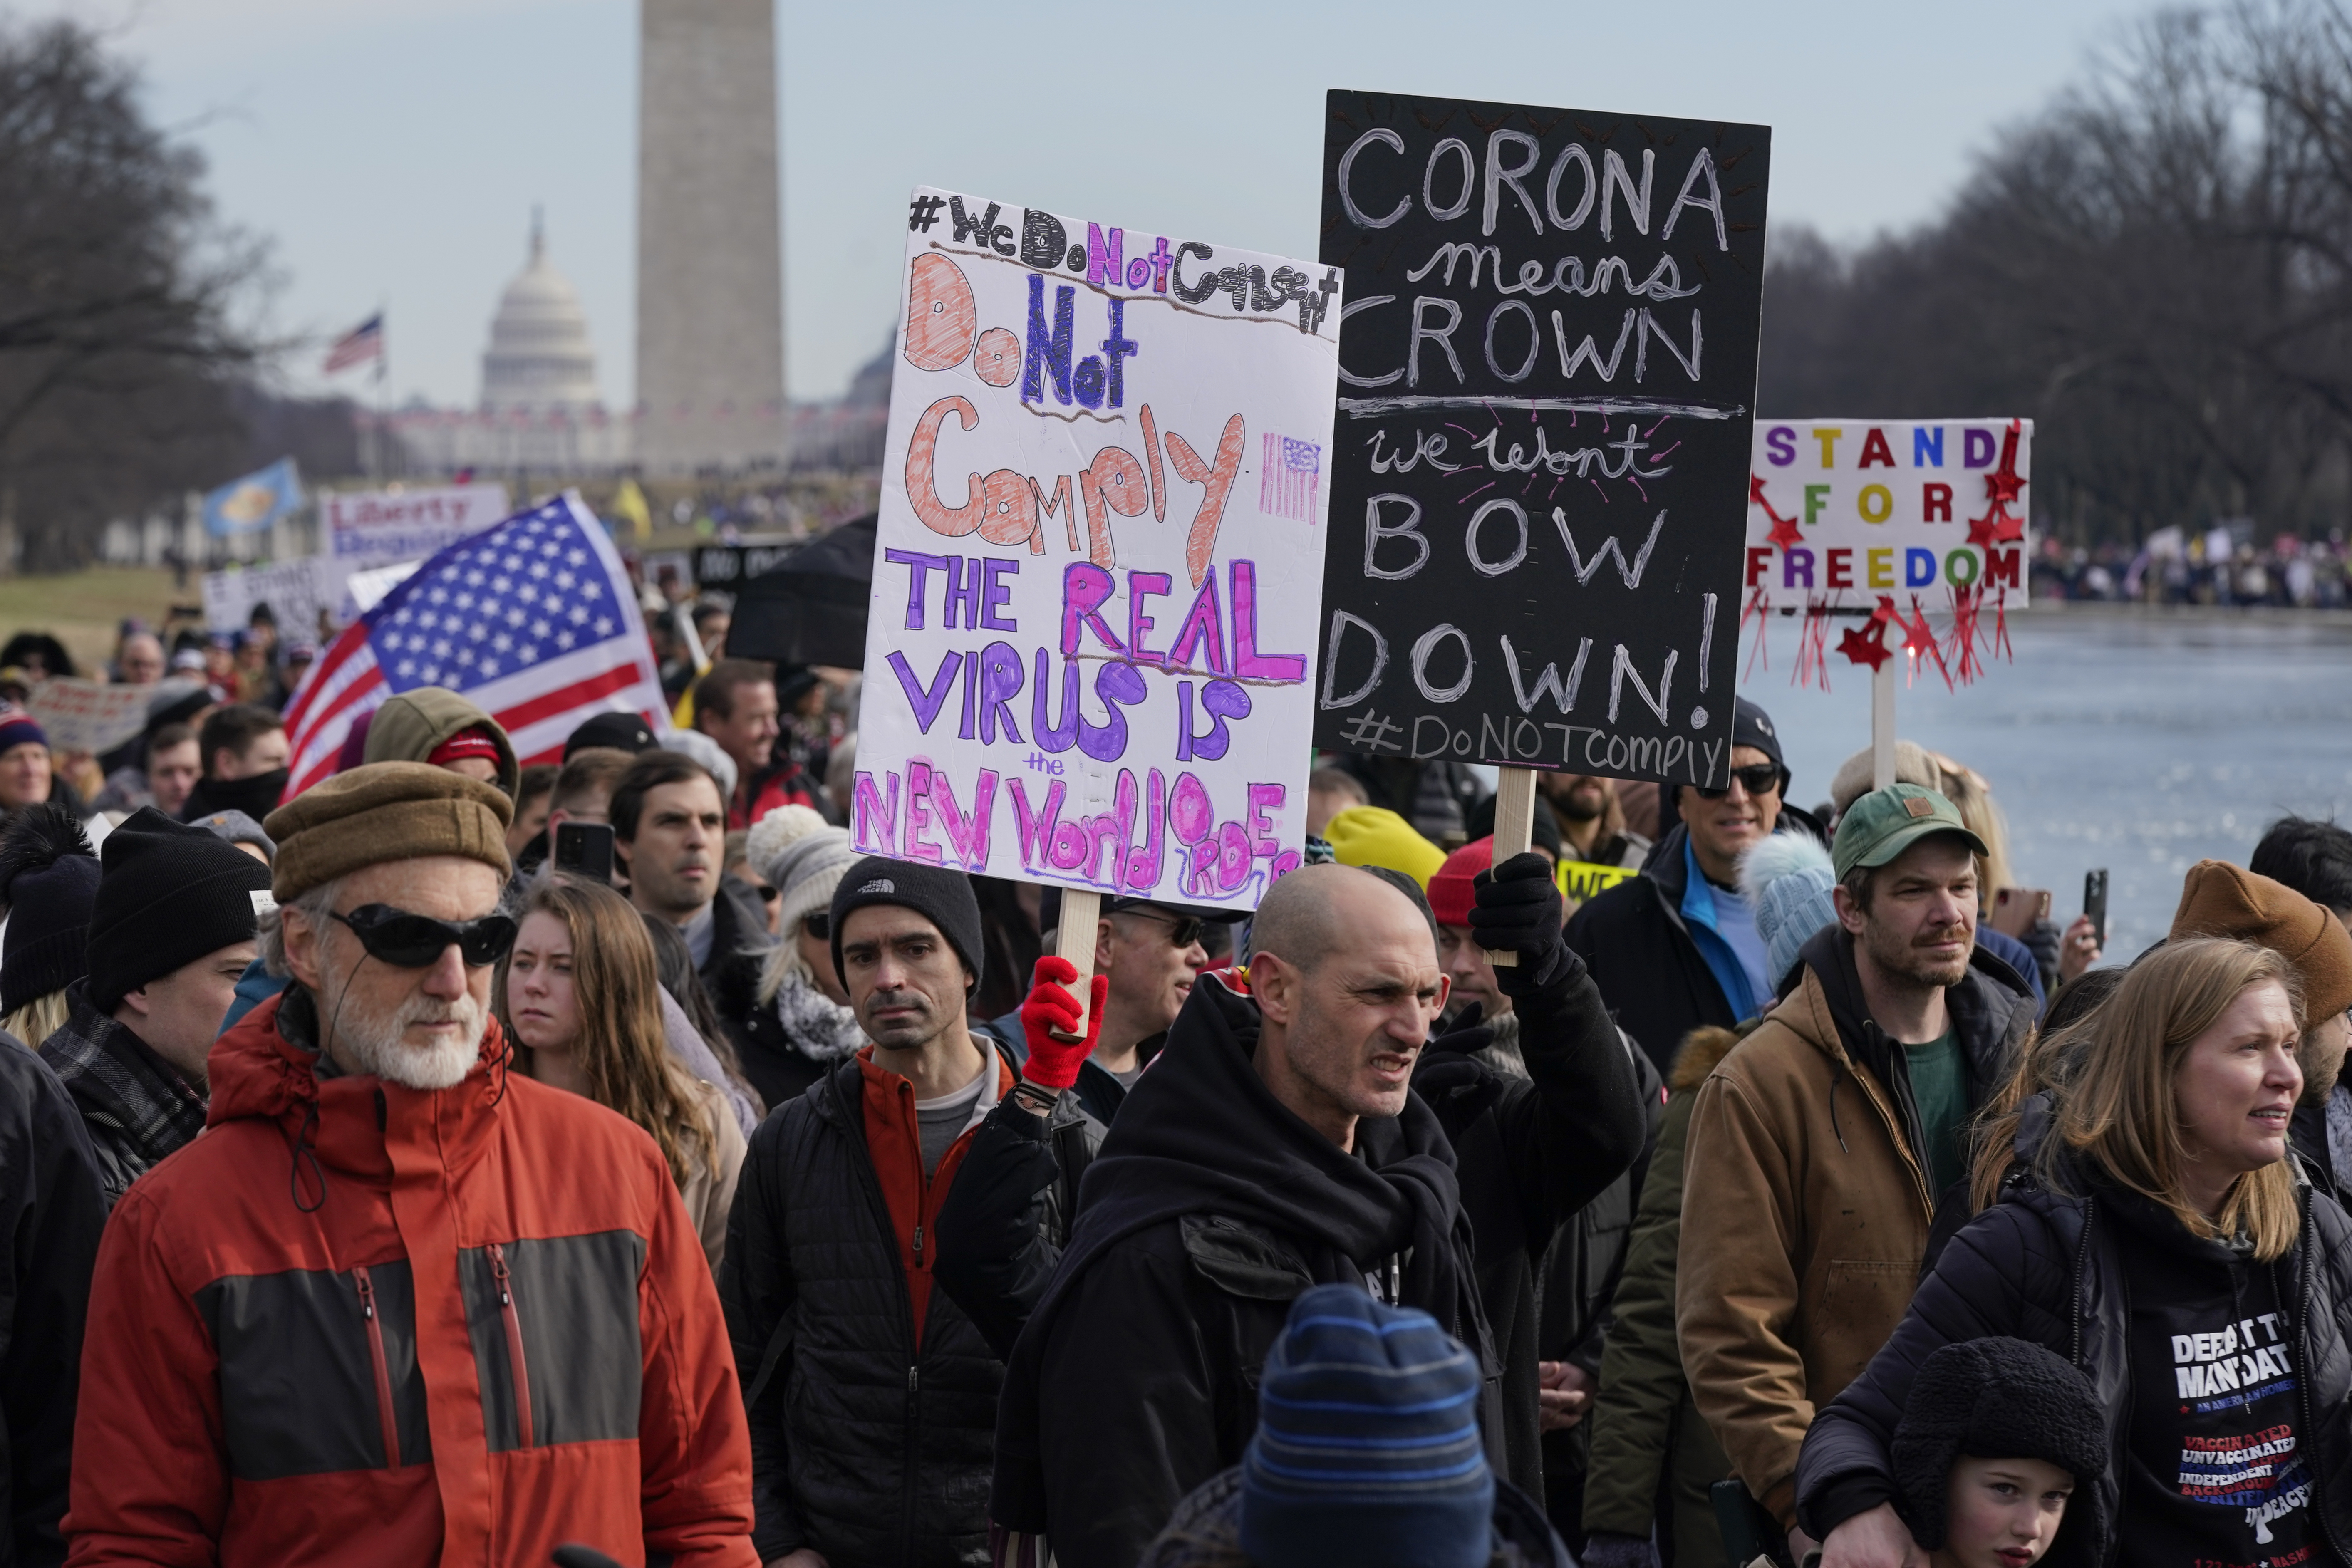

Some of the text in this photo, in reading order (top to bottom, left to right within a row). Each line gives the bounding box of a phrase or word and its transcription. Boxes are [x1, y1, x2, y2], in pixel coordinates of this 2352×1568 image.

[1339, 128, 1728, 251] CORONA
[1407, 242, 1702, 301] means
[905, 252, 1138, 408] Do Not
[1337, 295, 1703, 387] CROWN
[1766, 426, 1996, 468] STAND
[1804, 483, 1953, 524] FOR
[1363, 493, 1667, 589] BOW
[1747, 547, 2020, 589] FREEDOM
[885, 547, 1307, 683] THE REAL
[885, 640, 1252, 762] VIRUS IS
[1022, 752, 1065, 776] the
[850, 755, 999, 873] NEW
[2174, 1343, 2293, 1399] MANDAT
[2181, 1437, 2296, 1465] UNVACCINATED
[2184, 1424, 2292, 1452] VACCINATED
[2177, 1464, 2273, 1486] INDEPENDENT
